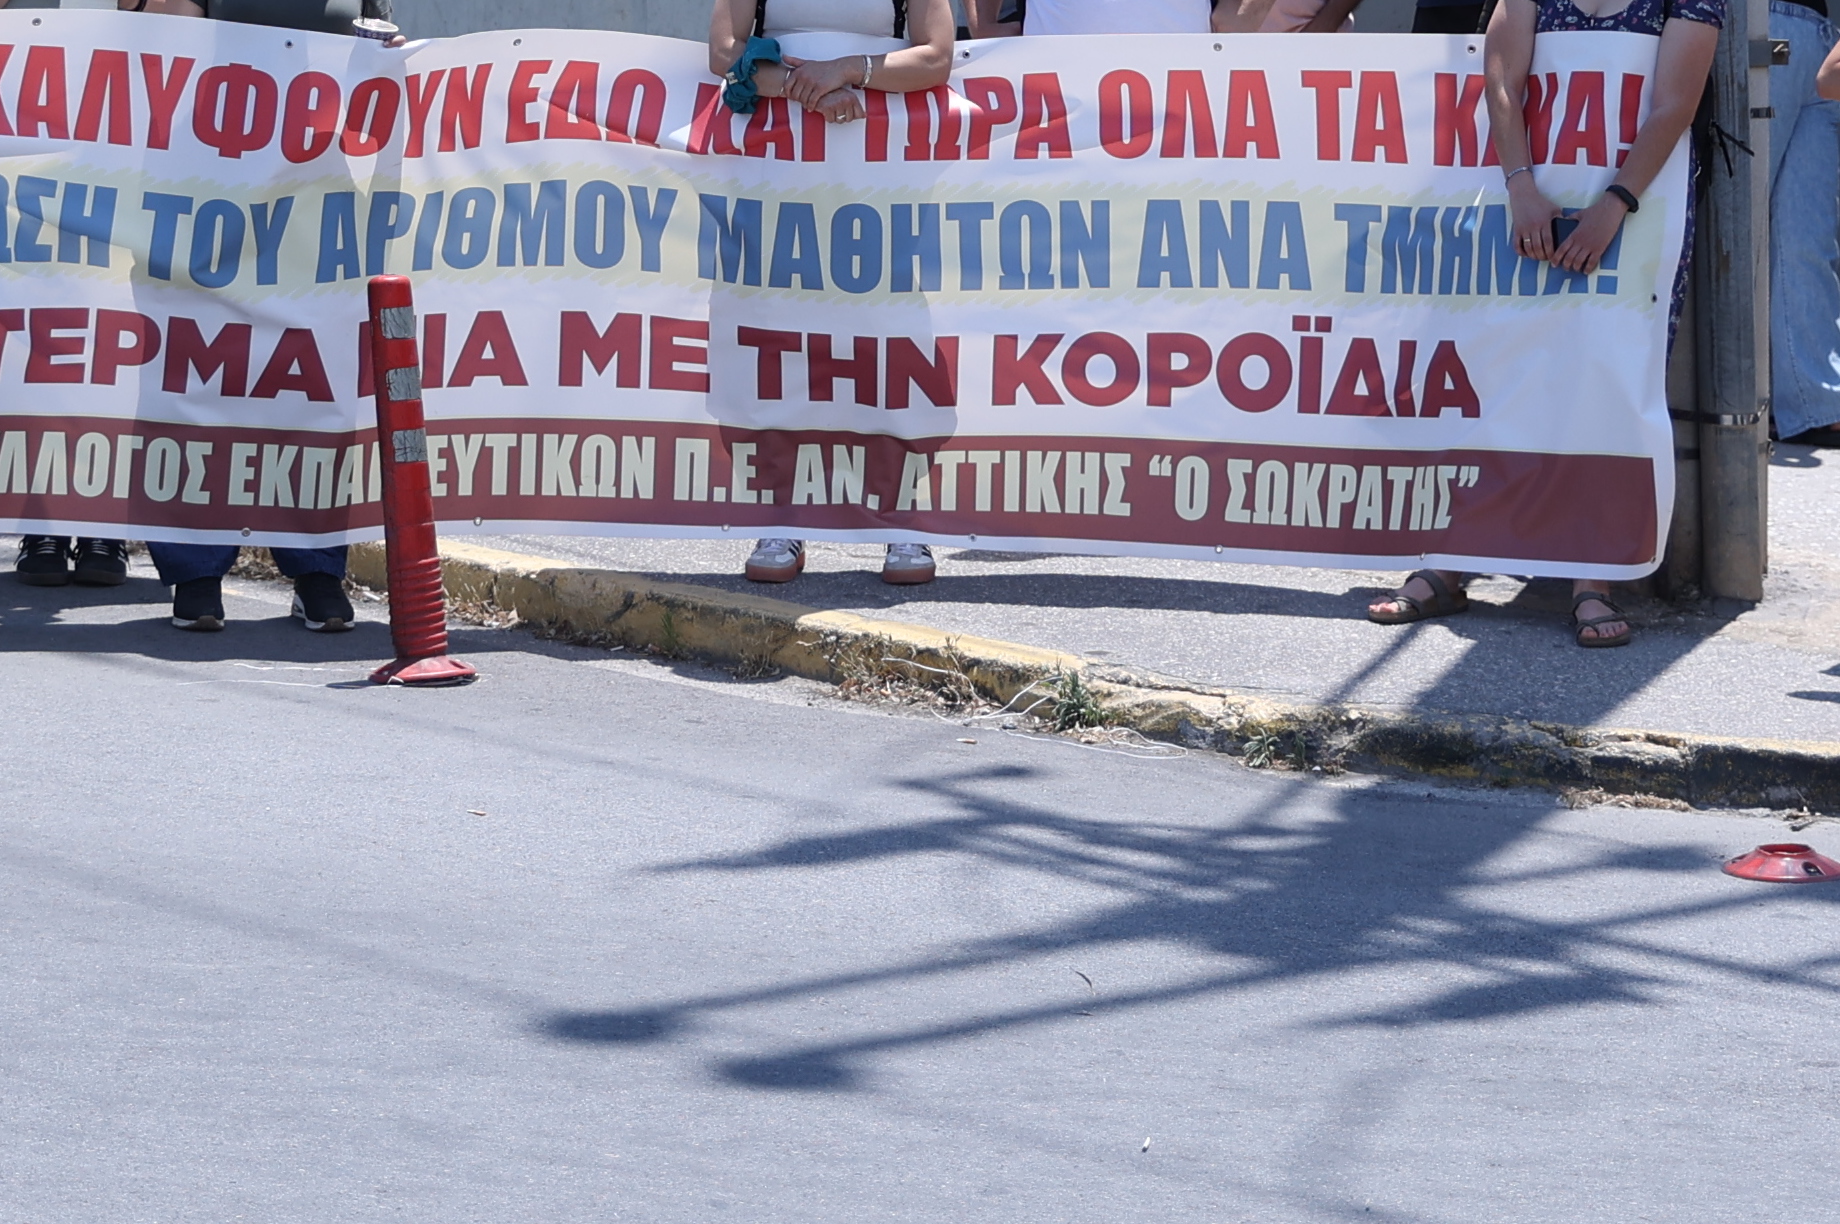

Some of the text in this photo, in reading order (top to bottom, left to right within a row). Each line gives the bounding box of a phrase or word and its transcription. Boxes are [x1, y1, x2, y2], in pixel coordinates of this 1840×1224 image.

[505, 59, 668, 149] ΕΔΩ
[1098, 68, 1281, 160] ΟΛΑ
[1301, 69, 1409, 165] ΤΑ
[1432, 70, 1646, 169] ΚΝΑ!
[142, 190, 296, 290] ΤΟΥ
[314, 179, 679, 284] ΑΡΙΘΜΟΥ
[697, 192, 1111, 294] ΜΑΘΗΤΩΝ
[1136, 198, 1313, 292] ΑΝΑ
[558, 310, 711, 394] ΜΕ
[736, 325, 960, 411] ΤΗΝ
[991, 314, 1482, 419] ΚΟΡΟΪΔΙΑ
[227, 432, 658, 511] ΕΚΠΑΙΕΥΤΙΚΩΝ
[673, 437, 774, 505] Π.Ε.
[791, 442, 880, 511] ΑΝ.
[895, 449, 1132, 517] ΑΤΤΙΚΗΣ
